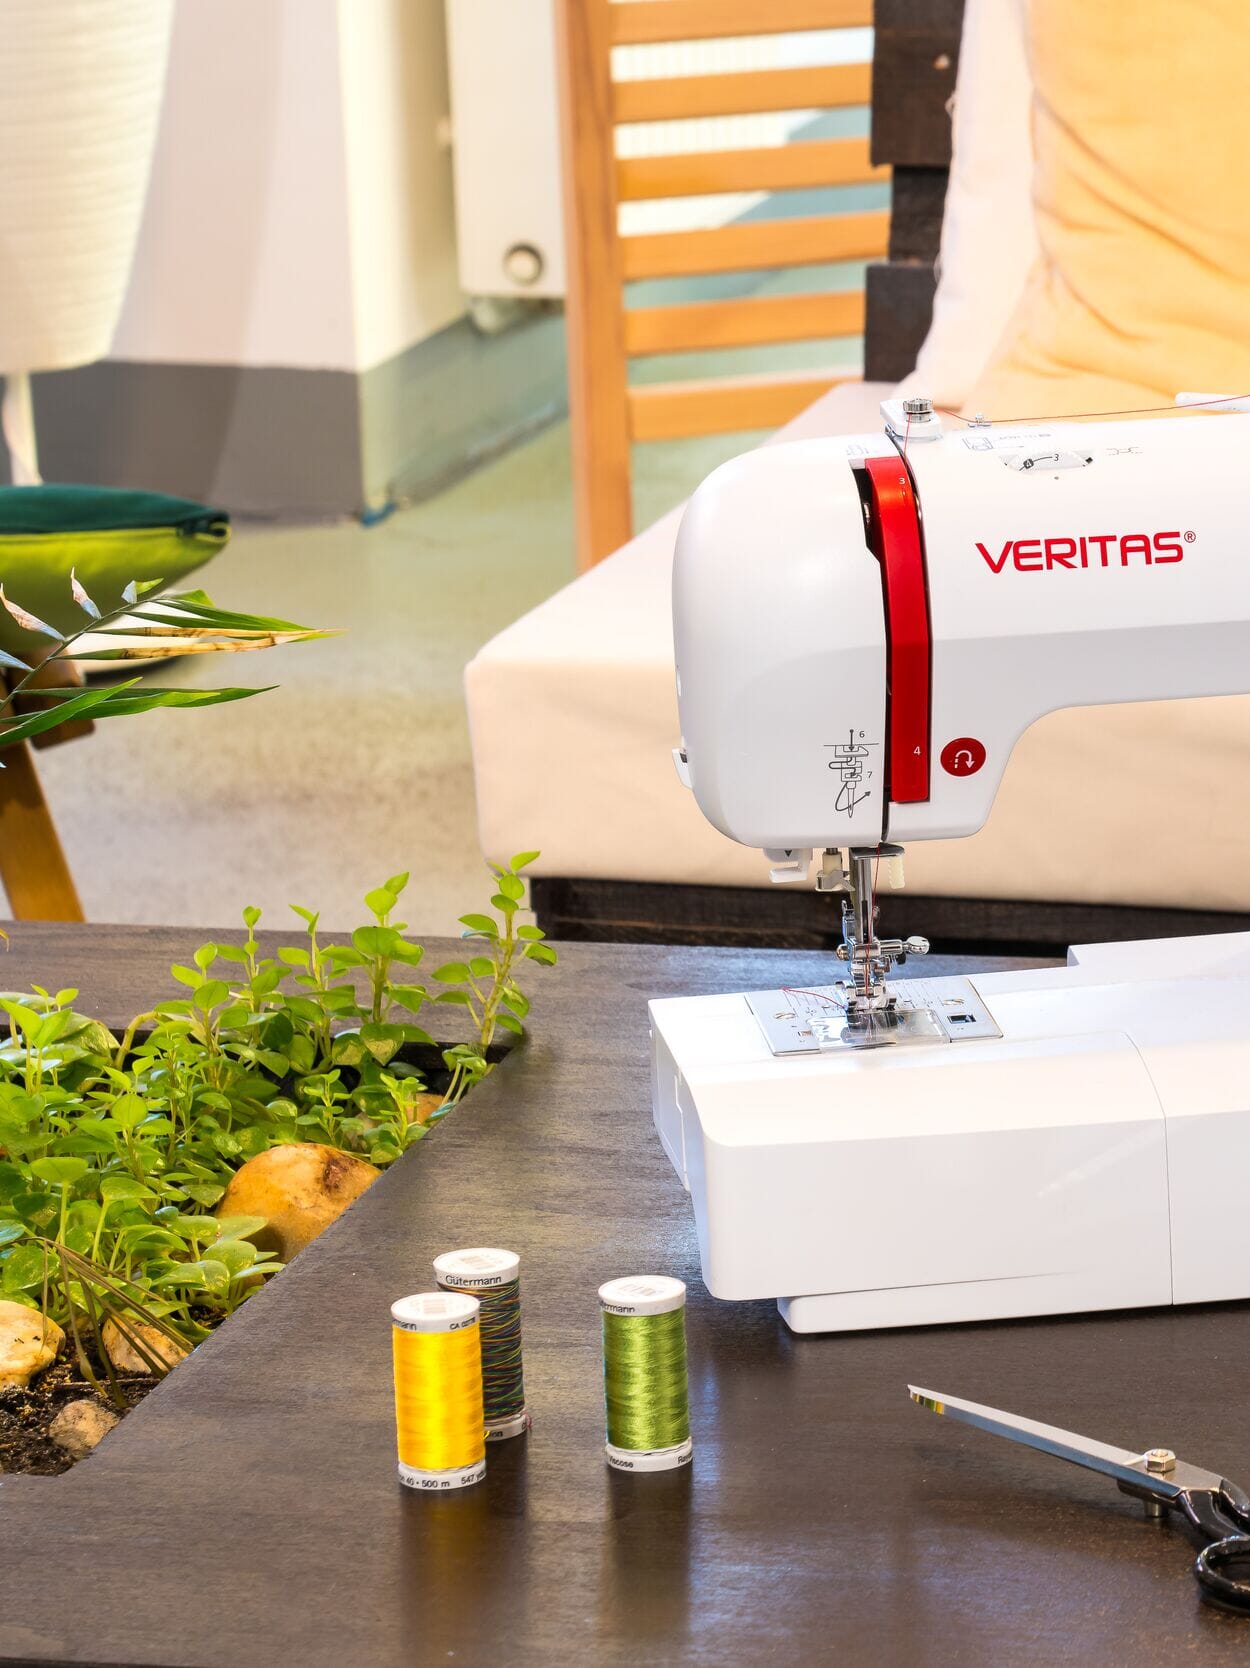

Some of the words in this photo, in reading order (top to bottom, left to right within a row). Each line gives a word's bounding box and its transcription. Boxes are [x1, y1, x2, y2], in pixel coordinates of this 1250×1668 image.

[1053, 453, 1060, 462] 3
[898, 477, 906, 485] 3
[858, 730, 866, 739] 6
[912, 746, 921, 756] 4
[866, 770, 873, 779] 7
[445, 1275, 502, 1287] Gütermann
[421, 1480, 438, 1488] 500
[461, 1474, 474, 1485] 547
